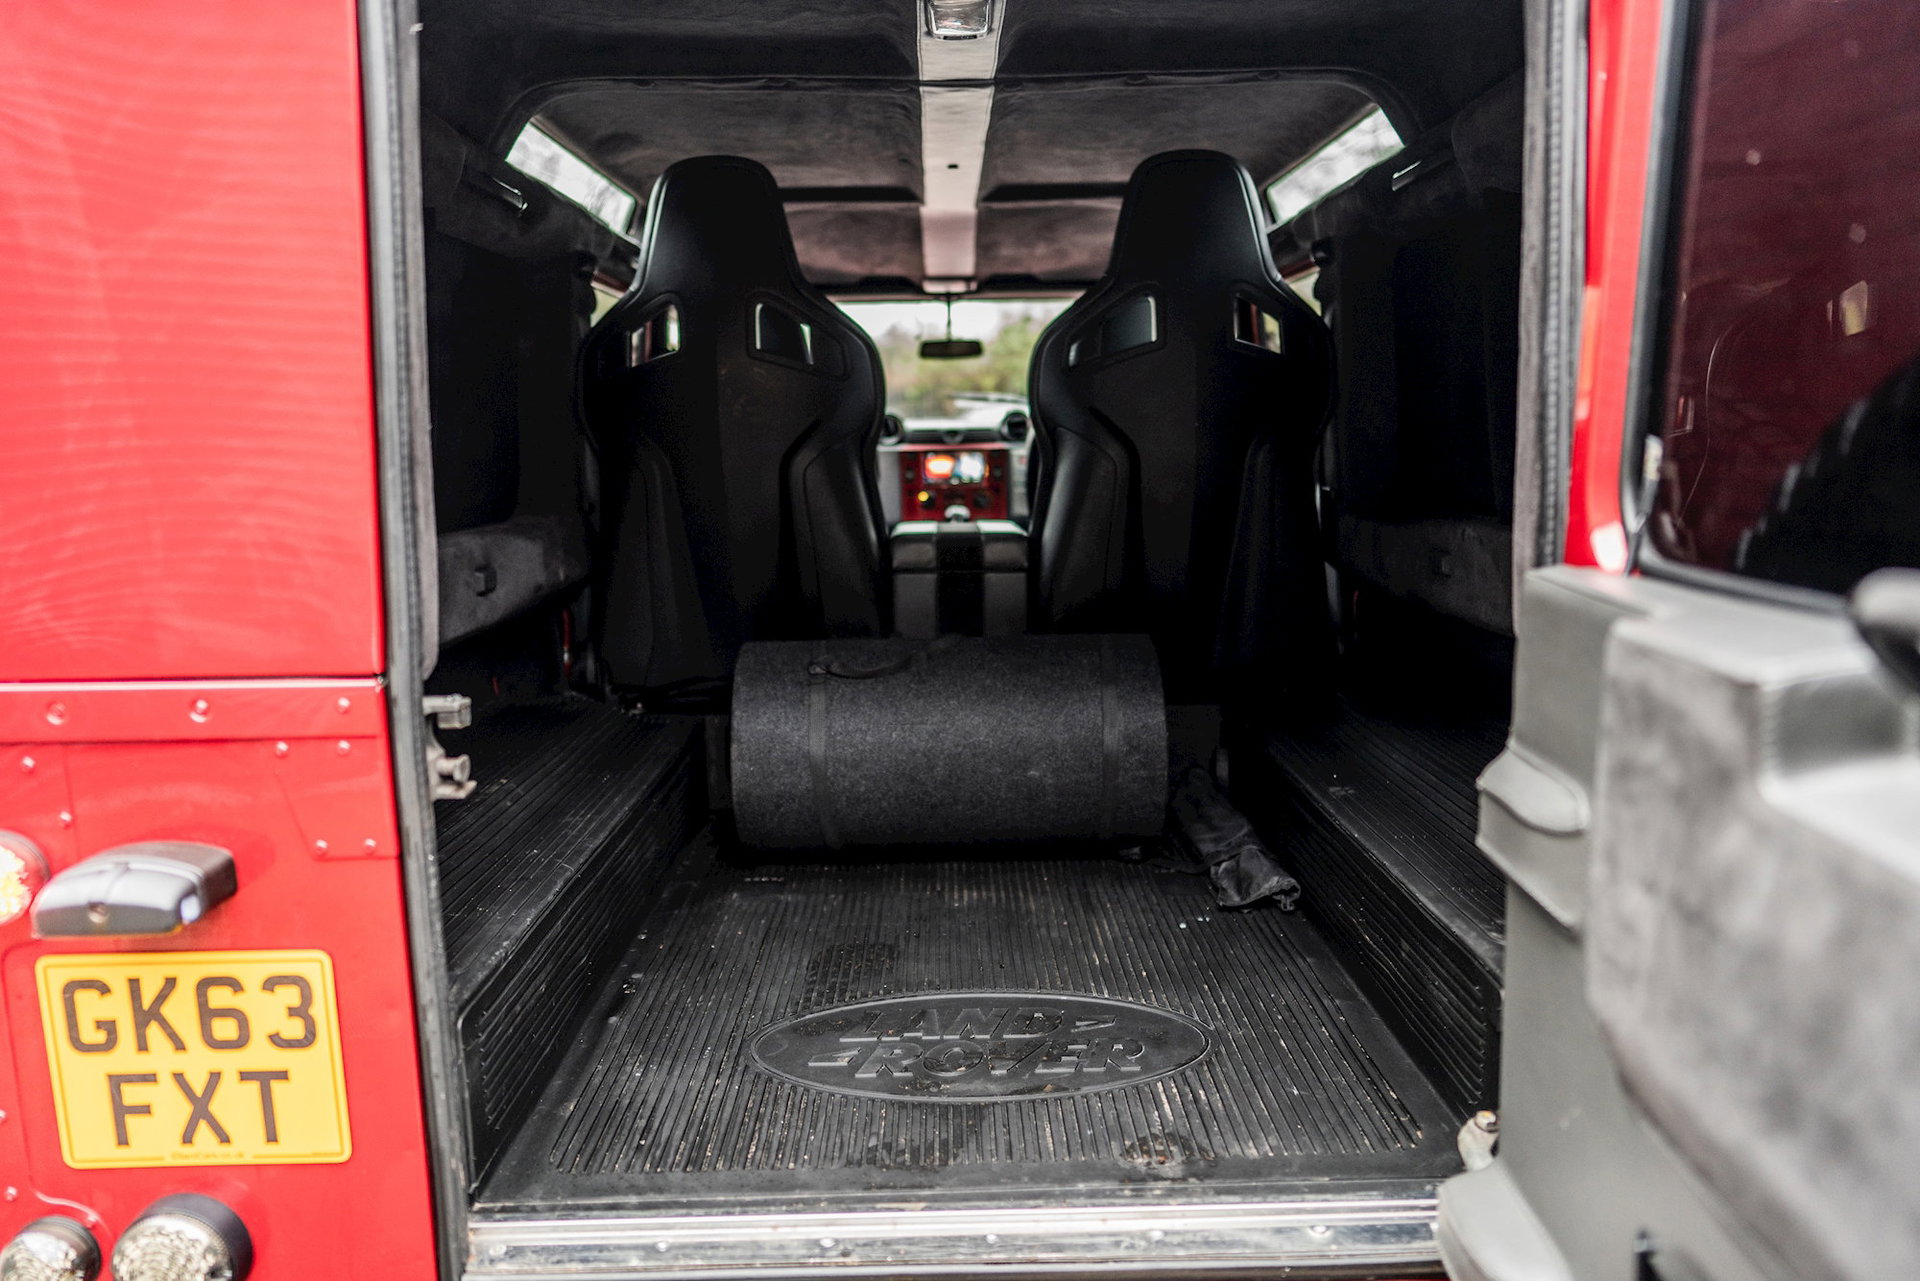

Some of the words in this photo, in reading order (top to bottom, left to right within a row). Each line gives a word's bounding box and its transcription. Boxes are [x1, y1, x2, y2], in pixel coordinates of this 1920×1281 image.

[62, 975, 317, 1053] GK63
[840, 1007, 1064, 1042] LAND
[855, 1038, 1145, 1078] ROVER
[107, 1070, 289, 1146] FXT
